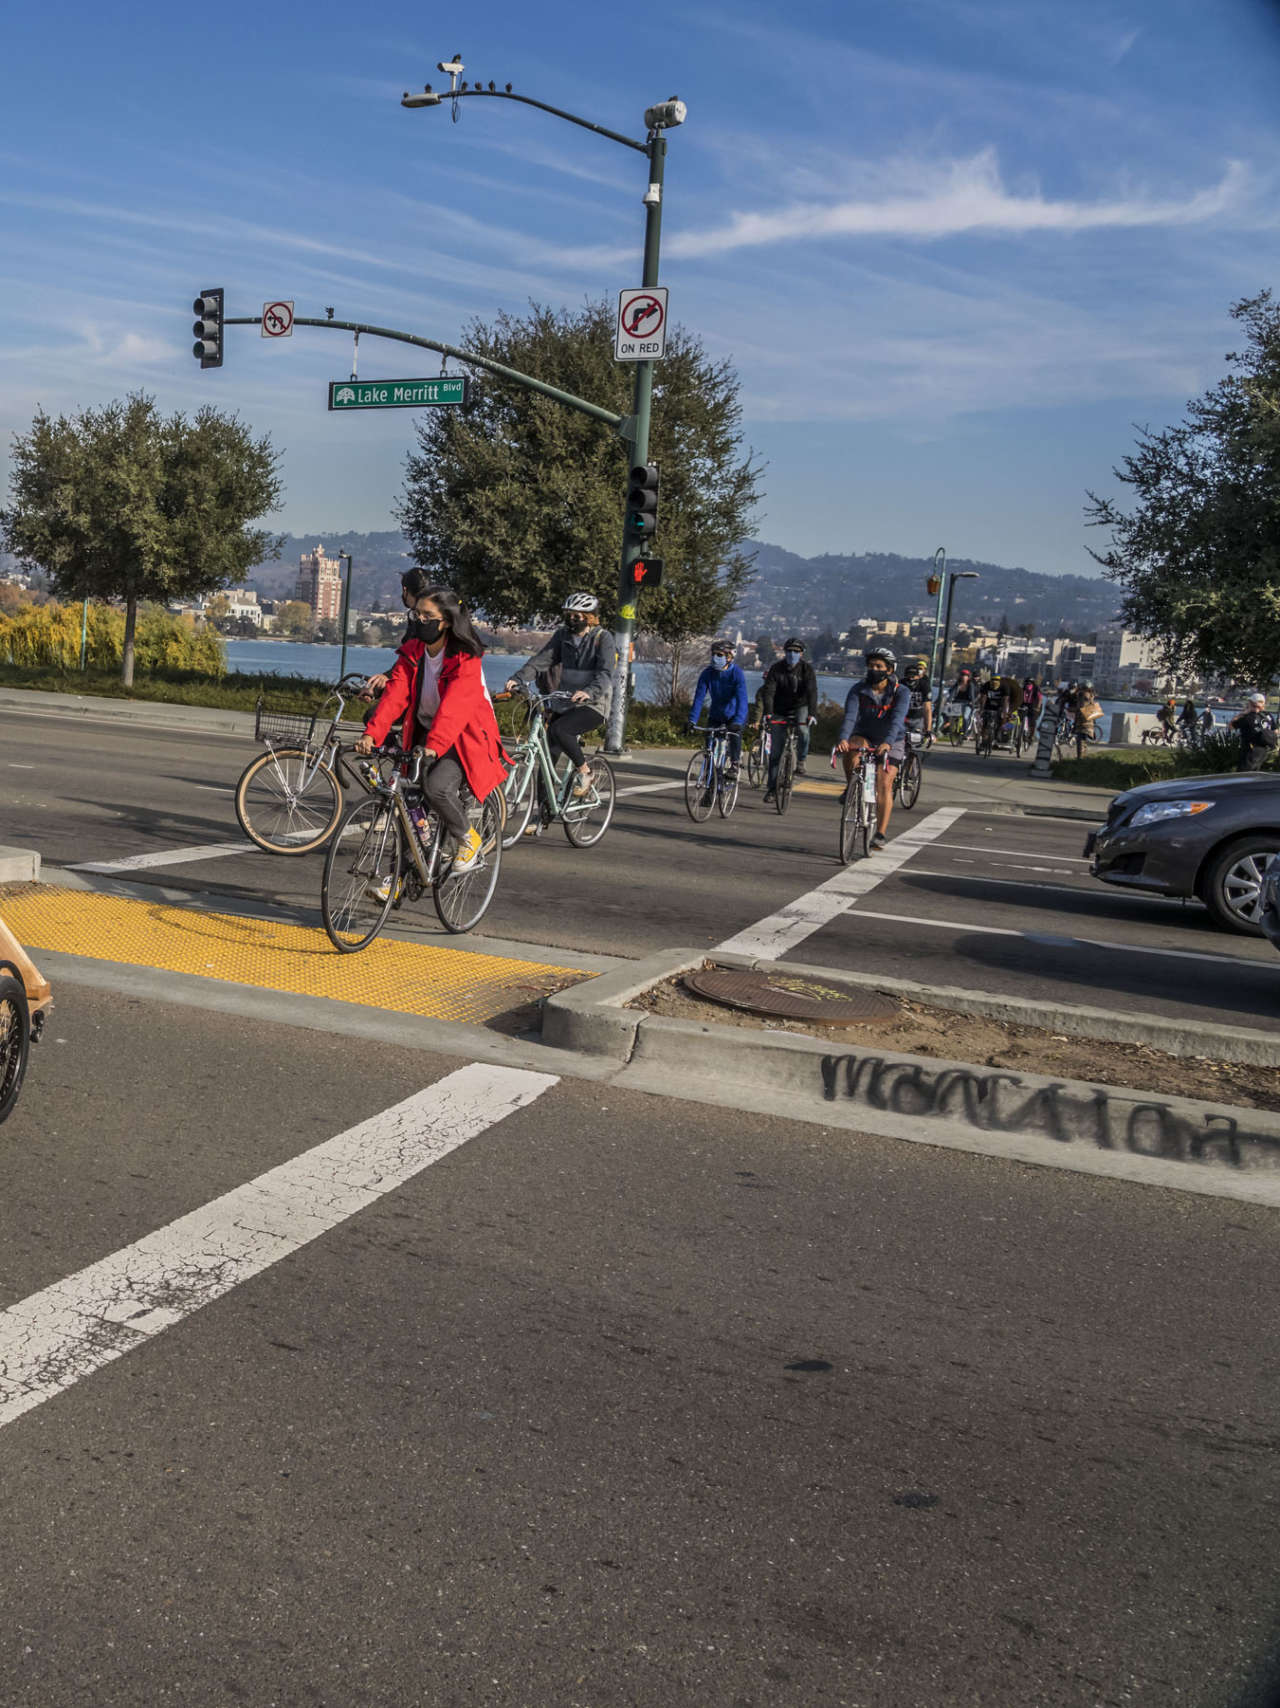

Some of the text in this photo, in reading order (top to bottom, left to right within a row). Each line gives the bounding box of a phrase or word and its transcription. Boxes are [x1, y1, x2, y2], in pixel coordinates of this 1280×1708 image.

[621, 342, 659, 354] ON RED
[357, 381, 462, 403] Lake Merritt Blvd
